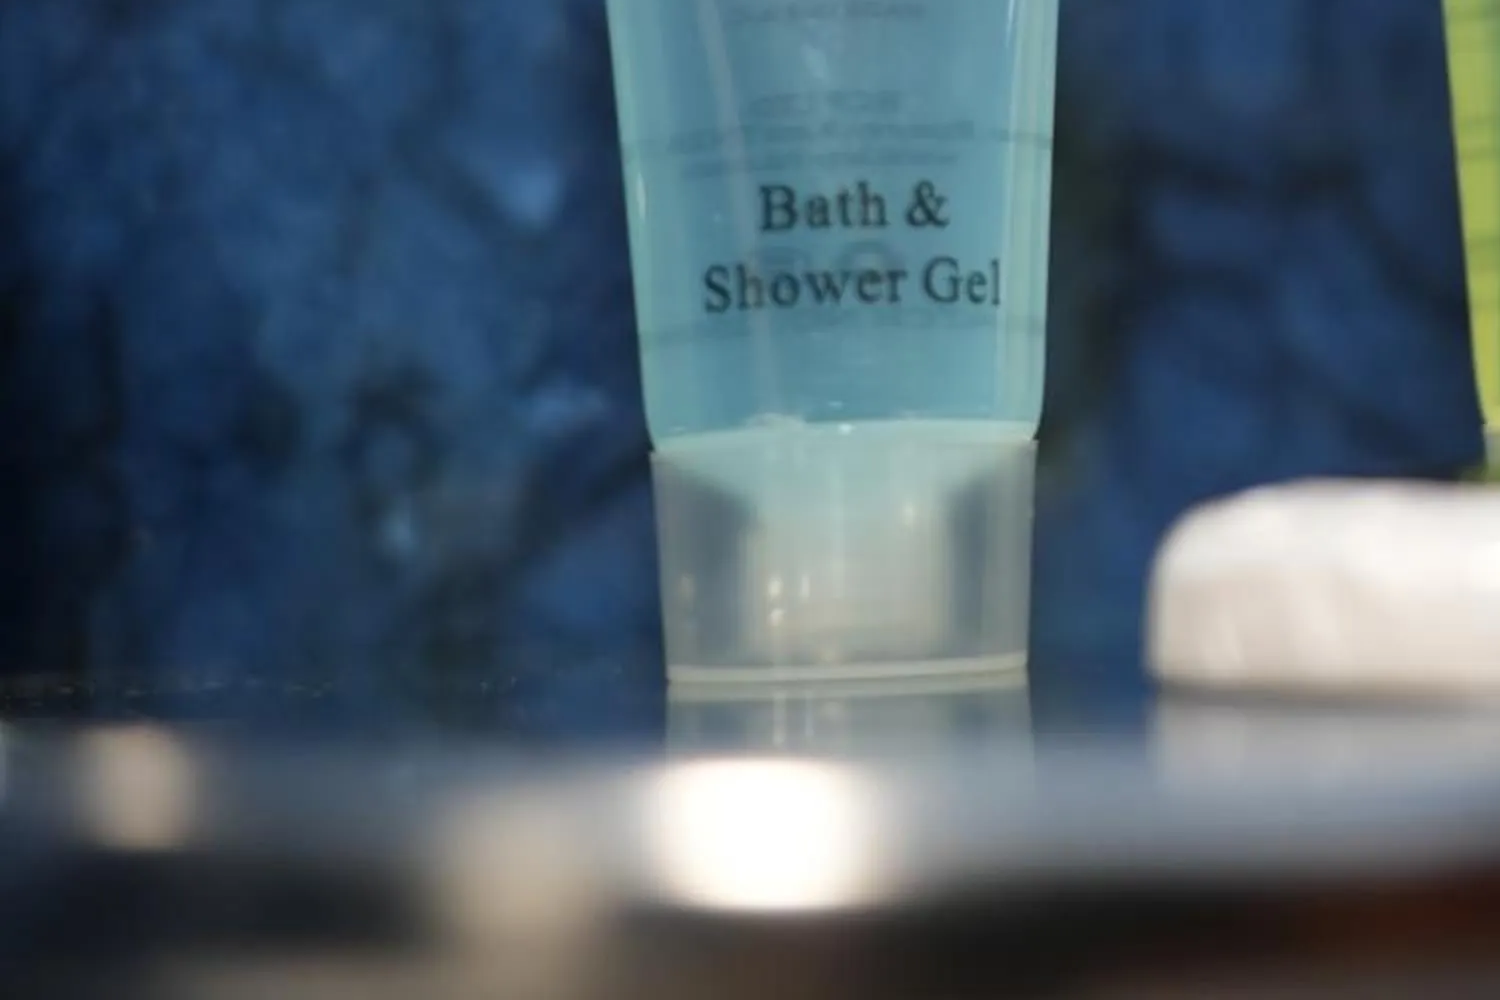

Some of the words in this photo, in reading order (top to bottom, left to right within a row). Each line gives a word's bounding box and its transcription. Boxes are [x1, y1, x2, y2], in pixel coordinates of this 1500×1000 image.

[759, 181, 890, 232] Bath
[905, 180, 950, 228] &
[703, 263, 908, 313] Shower
[923, 256, 1002, 306] Gel
